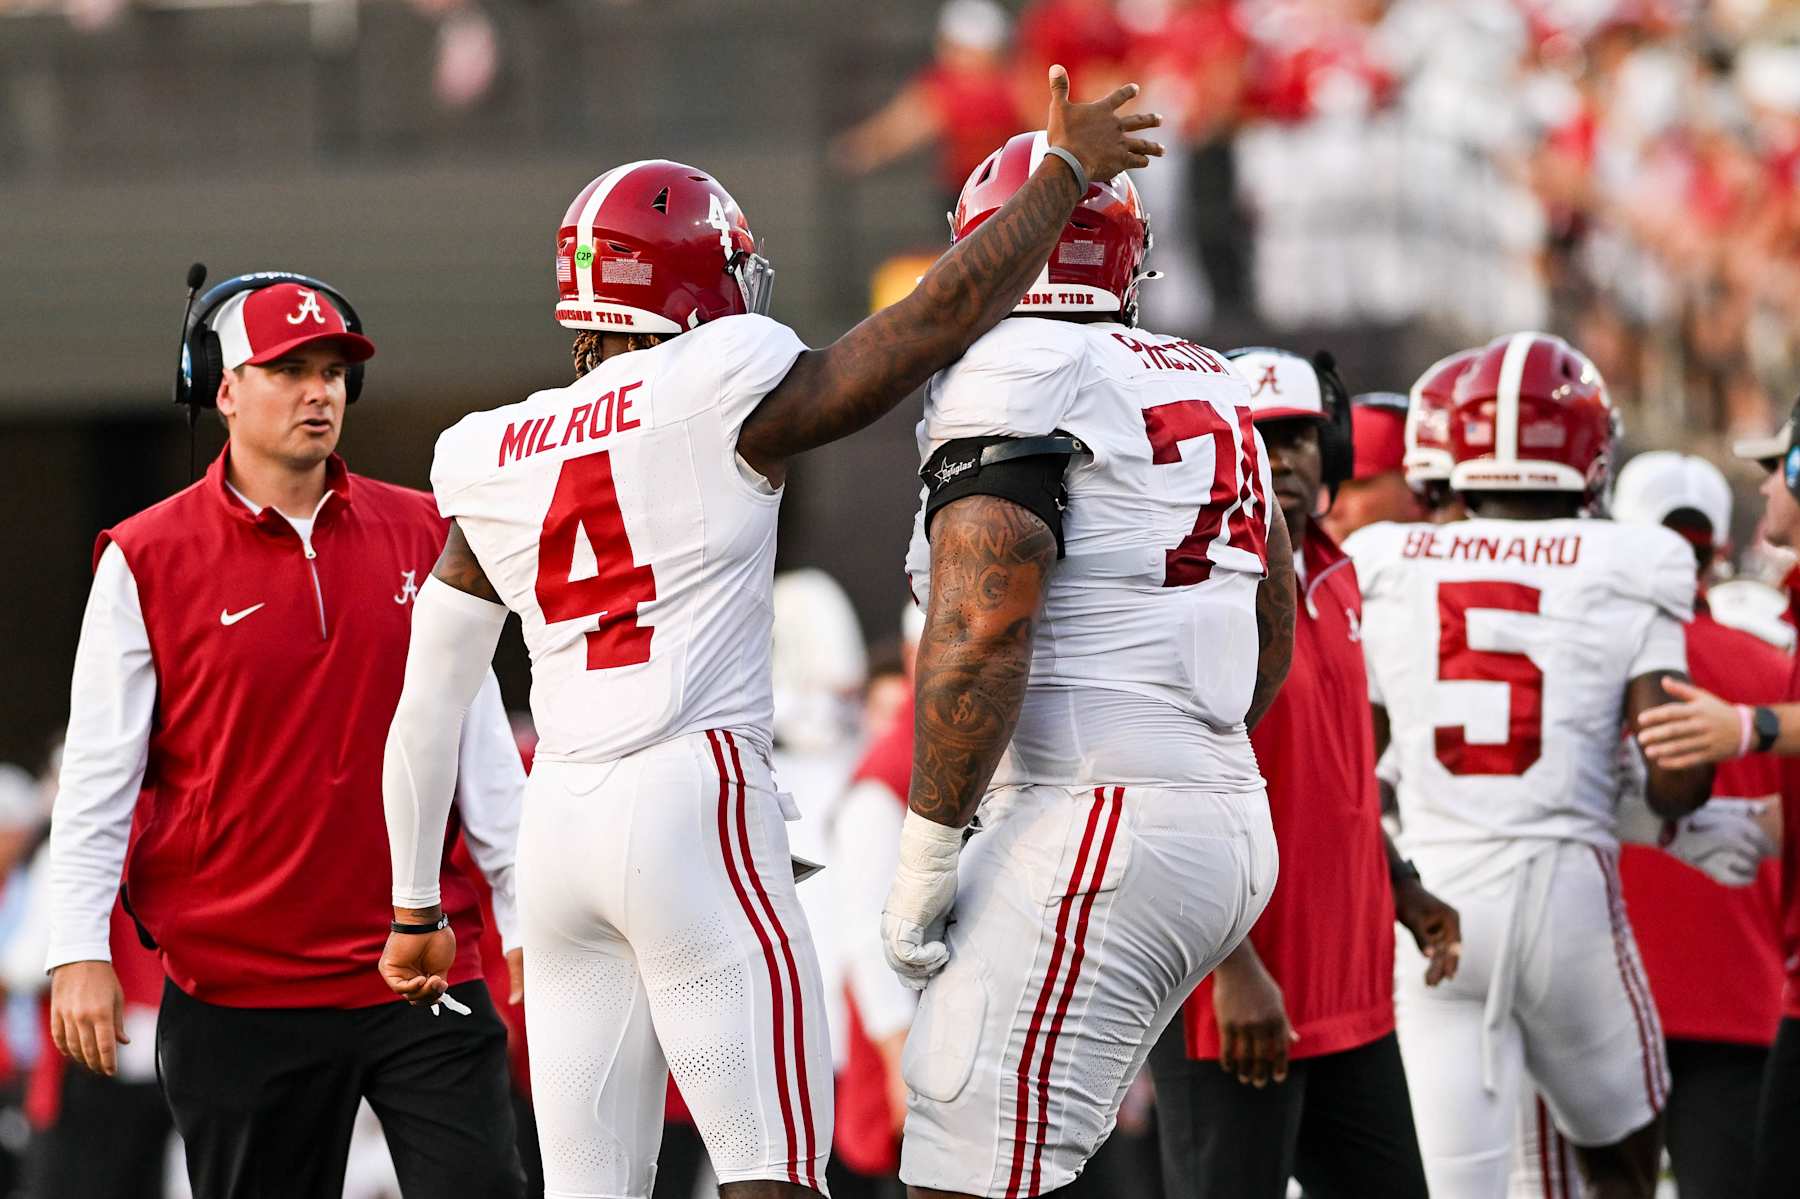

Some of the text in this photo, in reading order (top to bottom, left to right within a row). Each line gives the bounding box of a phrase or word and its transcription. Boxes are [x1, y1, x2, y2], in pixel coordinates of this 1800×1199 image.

[709, 193, 733, 262] 4
[576, 251, 593, 261] C2P
[286, 290, 325, 324] A
[1058, 293, 1094, 304] TIDE
[596, 312, 634, 325] TIDE
[498, 380, 643, 467] MILROE
[535, 449, 657, 671] 4
[1402, 532, 1582, 566] BERNARD
[1434, 580, 1543, 777] 5
